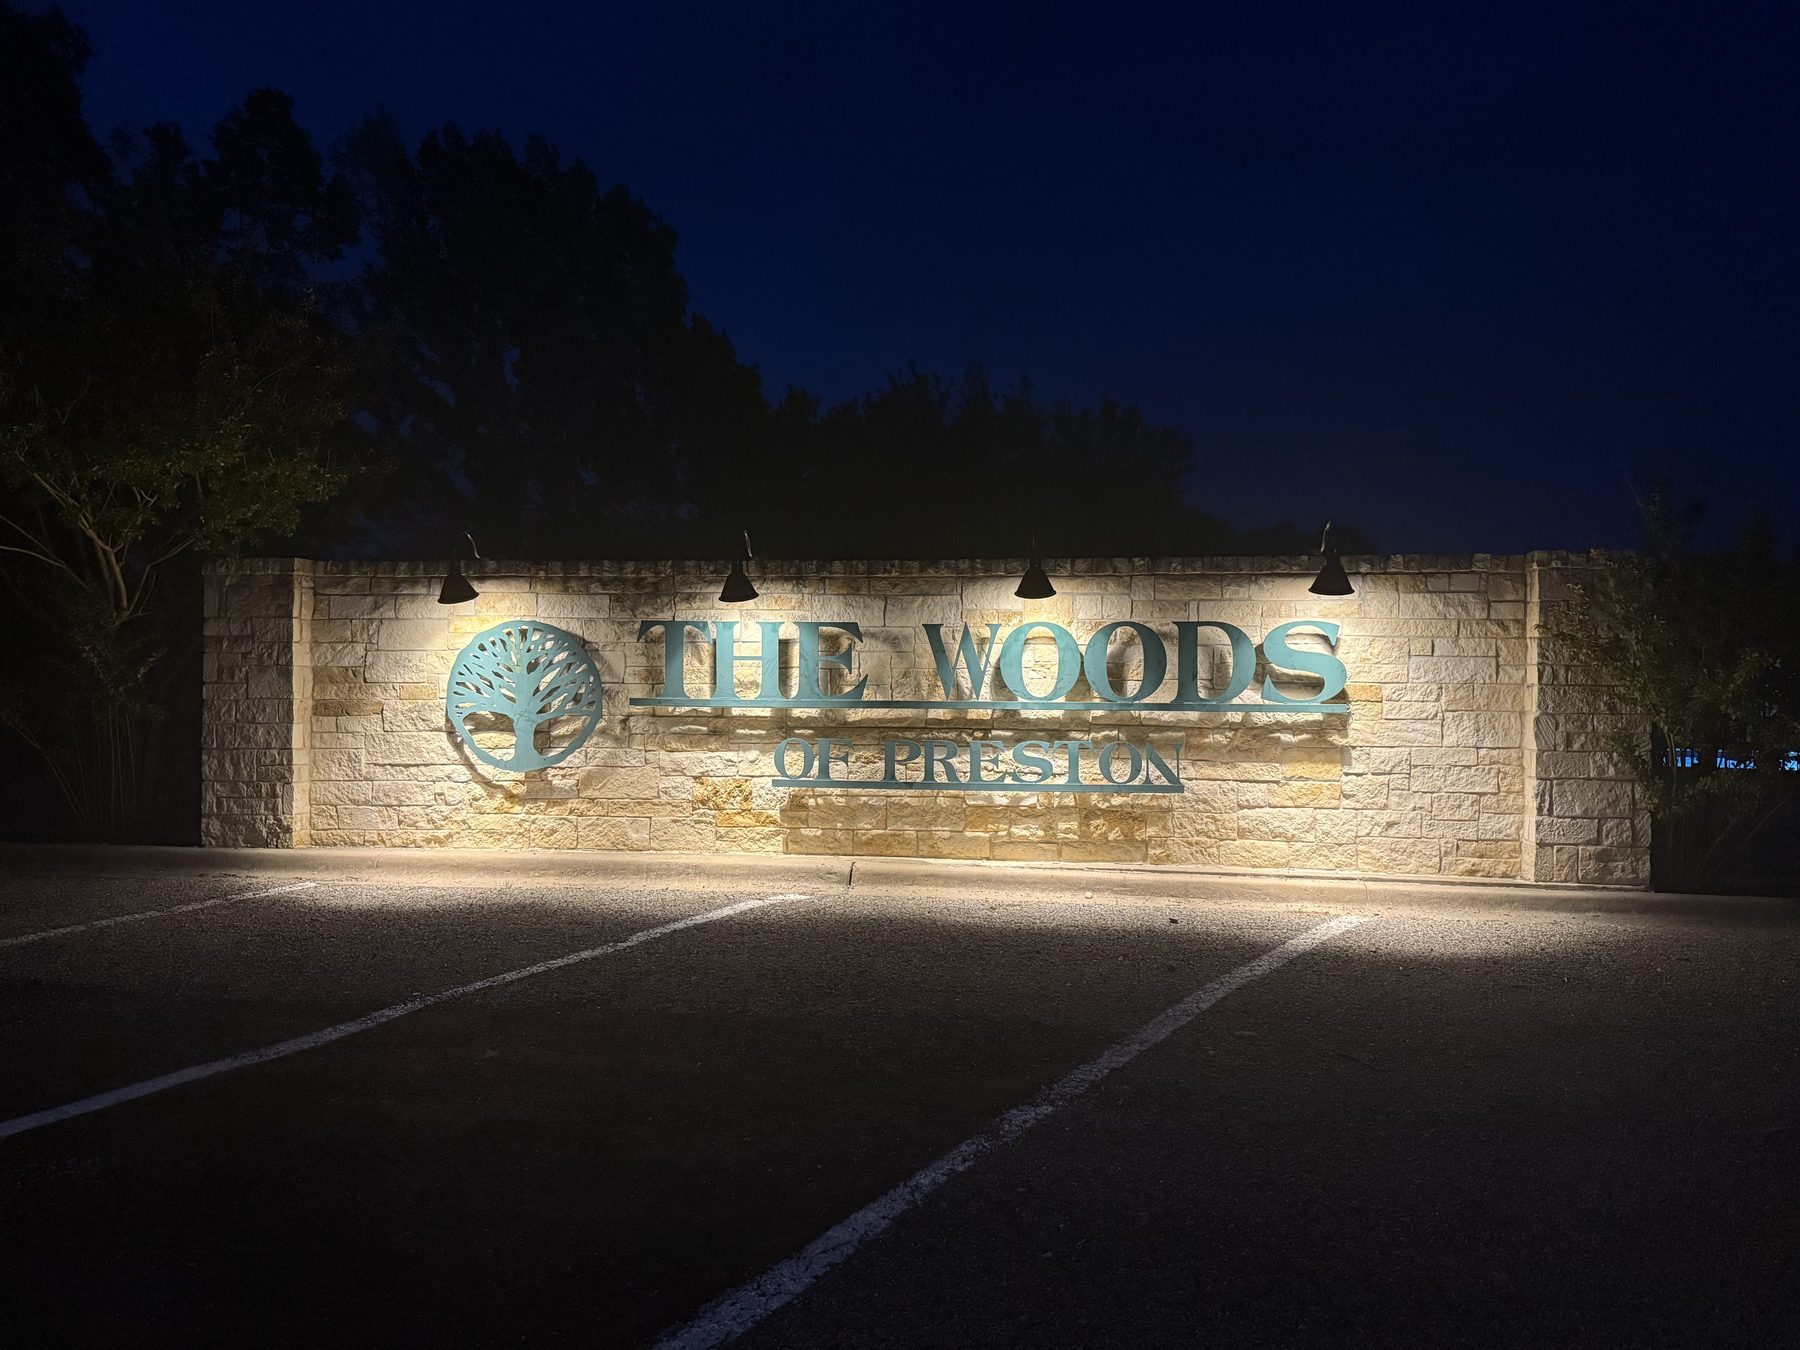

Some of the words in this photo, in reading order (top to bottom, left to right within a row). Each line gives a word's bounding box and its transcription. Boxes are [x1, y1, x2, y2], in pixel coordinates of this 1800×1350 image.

[637, 621, 868, 700] THE
[922, 620, 1347, 703] WOODS
[773, 738, 850, 780] OF
[881, 740, 1182, 784] PRESTON
